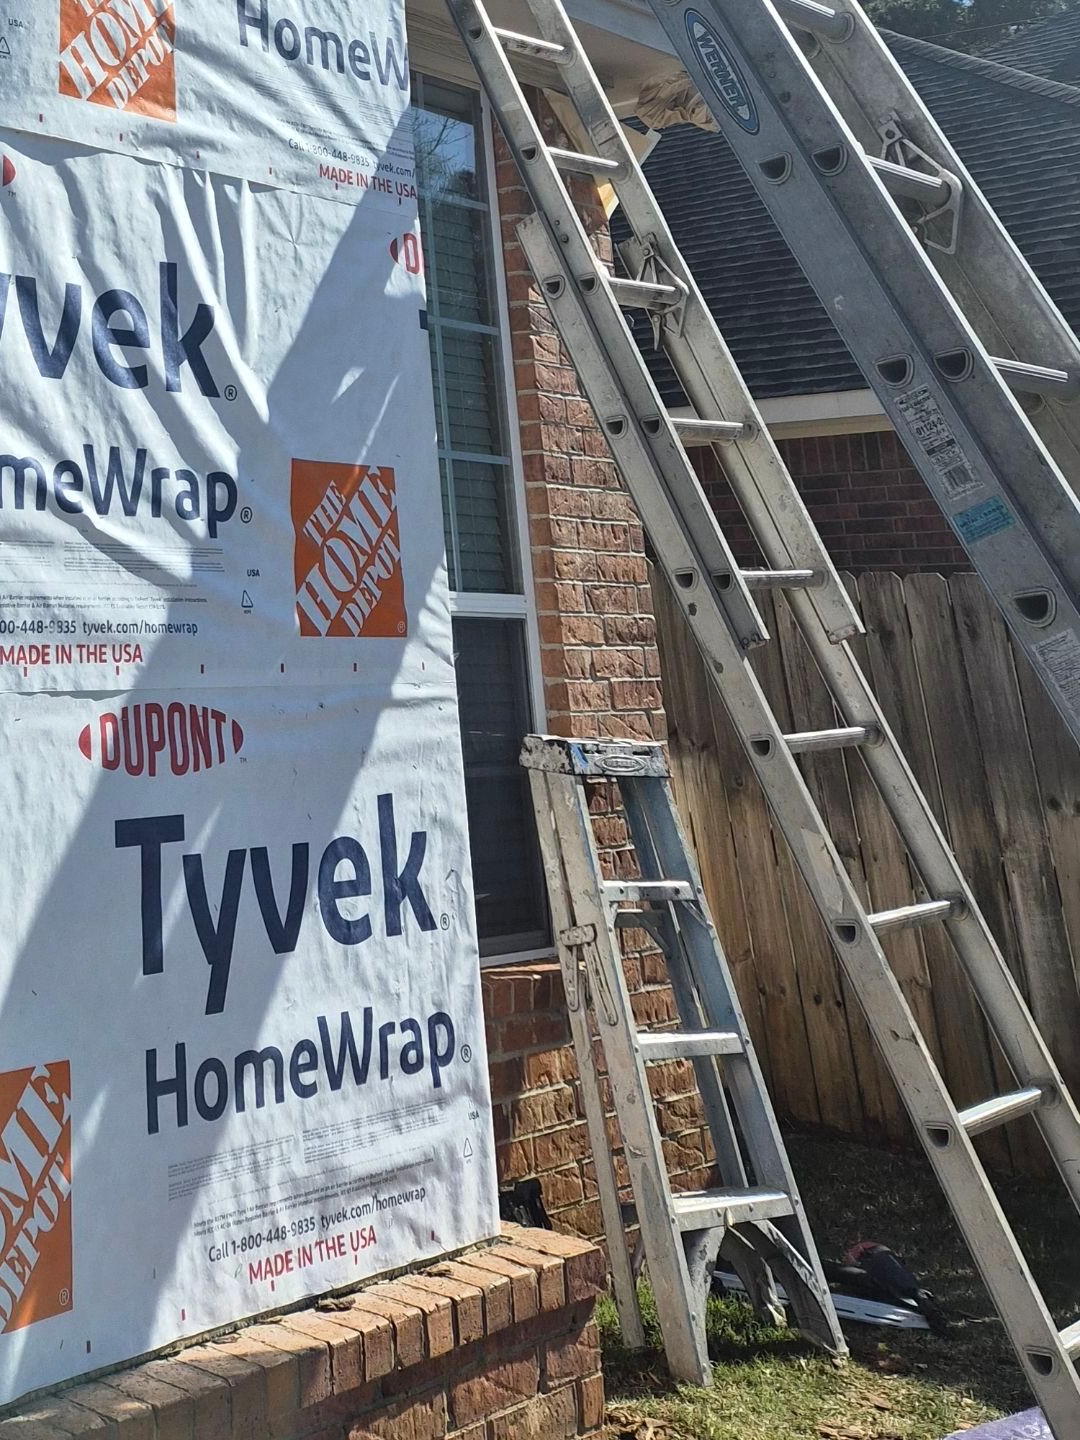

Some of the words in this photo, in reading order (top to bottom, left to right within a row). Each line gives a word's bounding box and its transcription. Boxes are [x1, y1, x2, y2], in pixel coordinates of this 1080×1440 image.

[106, 21, 174, 110] DEPOT
[696, 30, 748, 107] WERNER
[319, 163, 354, 186] MADE
[356, 173, 369, 190] IN
[371, 176, 393, 194] THE
[395, 181, 417, 199] USA
[296, 465, 397, 638] HOME
[303, 479, 347, 548] THE
[246, 569, 261, 577] USA
[340, 528, 401, 638] DEPOT
[0, 644, 51, 666] MADE
[55, 644, 73, 665] IN
[76, 644, 108, 664] THE
[112, 643, 143, 664] USA
[82, 619, 198, 636] tyvek.com/homewrap
[98, 701, 228, 777] DUPONT
[114, 793, 438, 1015] Tyvek
[144, 1006, 456, 1136] HomeWrap
[208, 1241, 229, 1263] Call
[231, 1216, 316, 1255] 1-800-448-9835
[321, 1186, 426, 1231] tyvek.com/homewrap
[248, 1250, 294, 1285] MADE
[298, 1244, 314, 1269] IN
[315, 1233, 347, 1262] THE
[350, 1224, 377, 1253] USA
